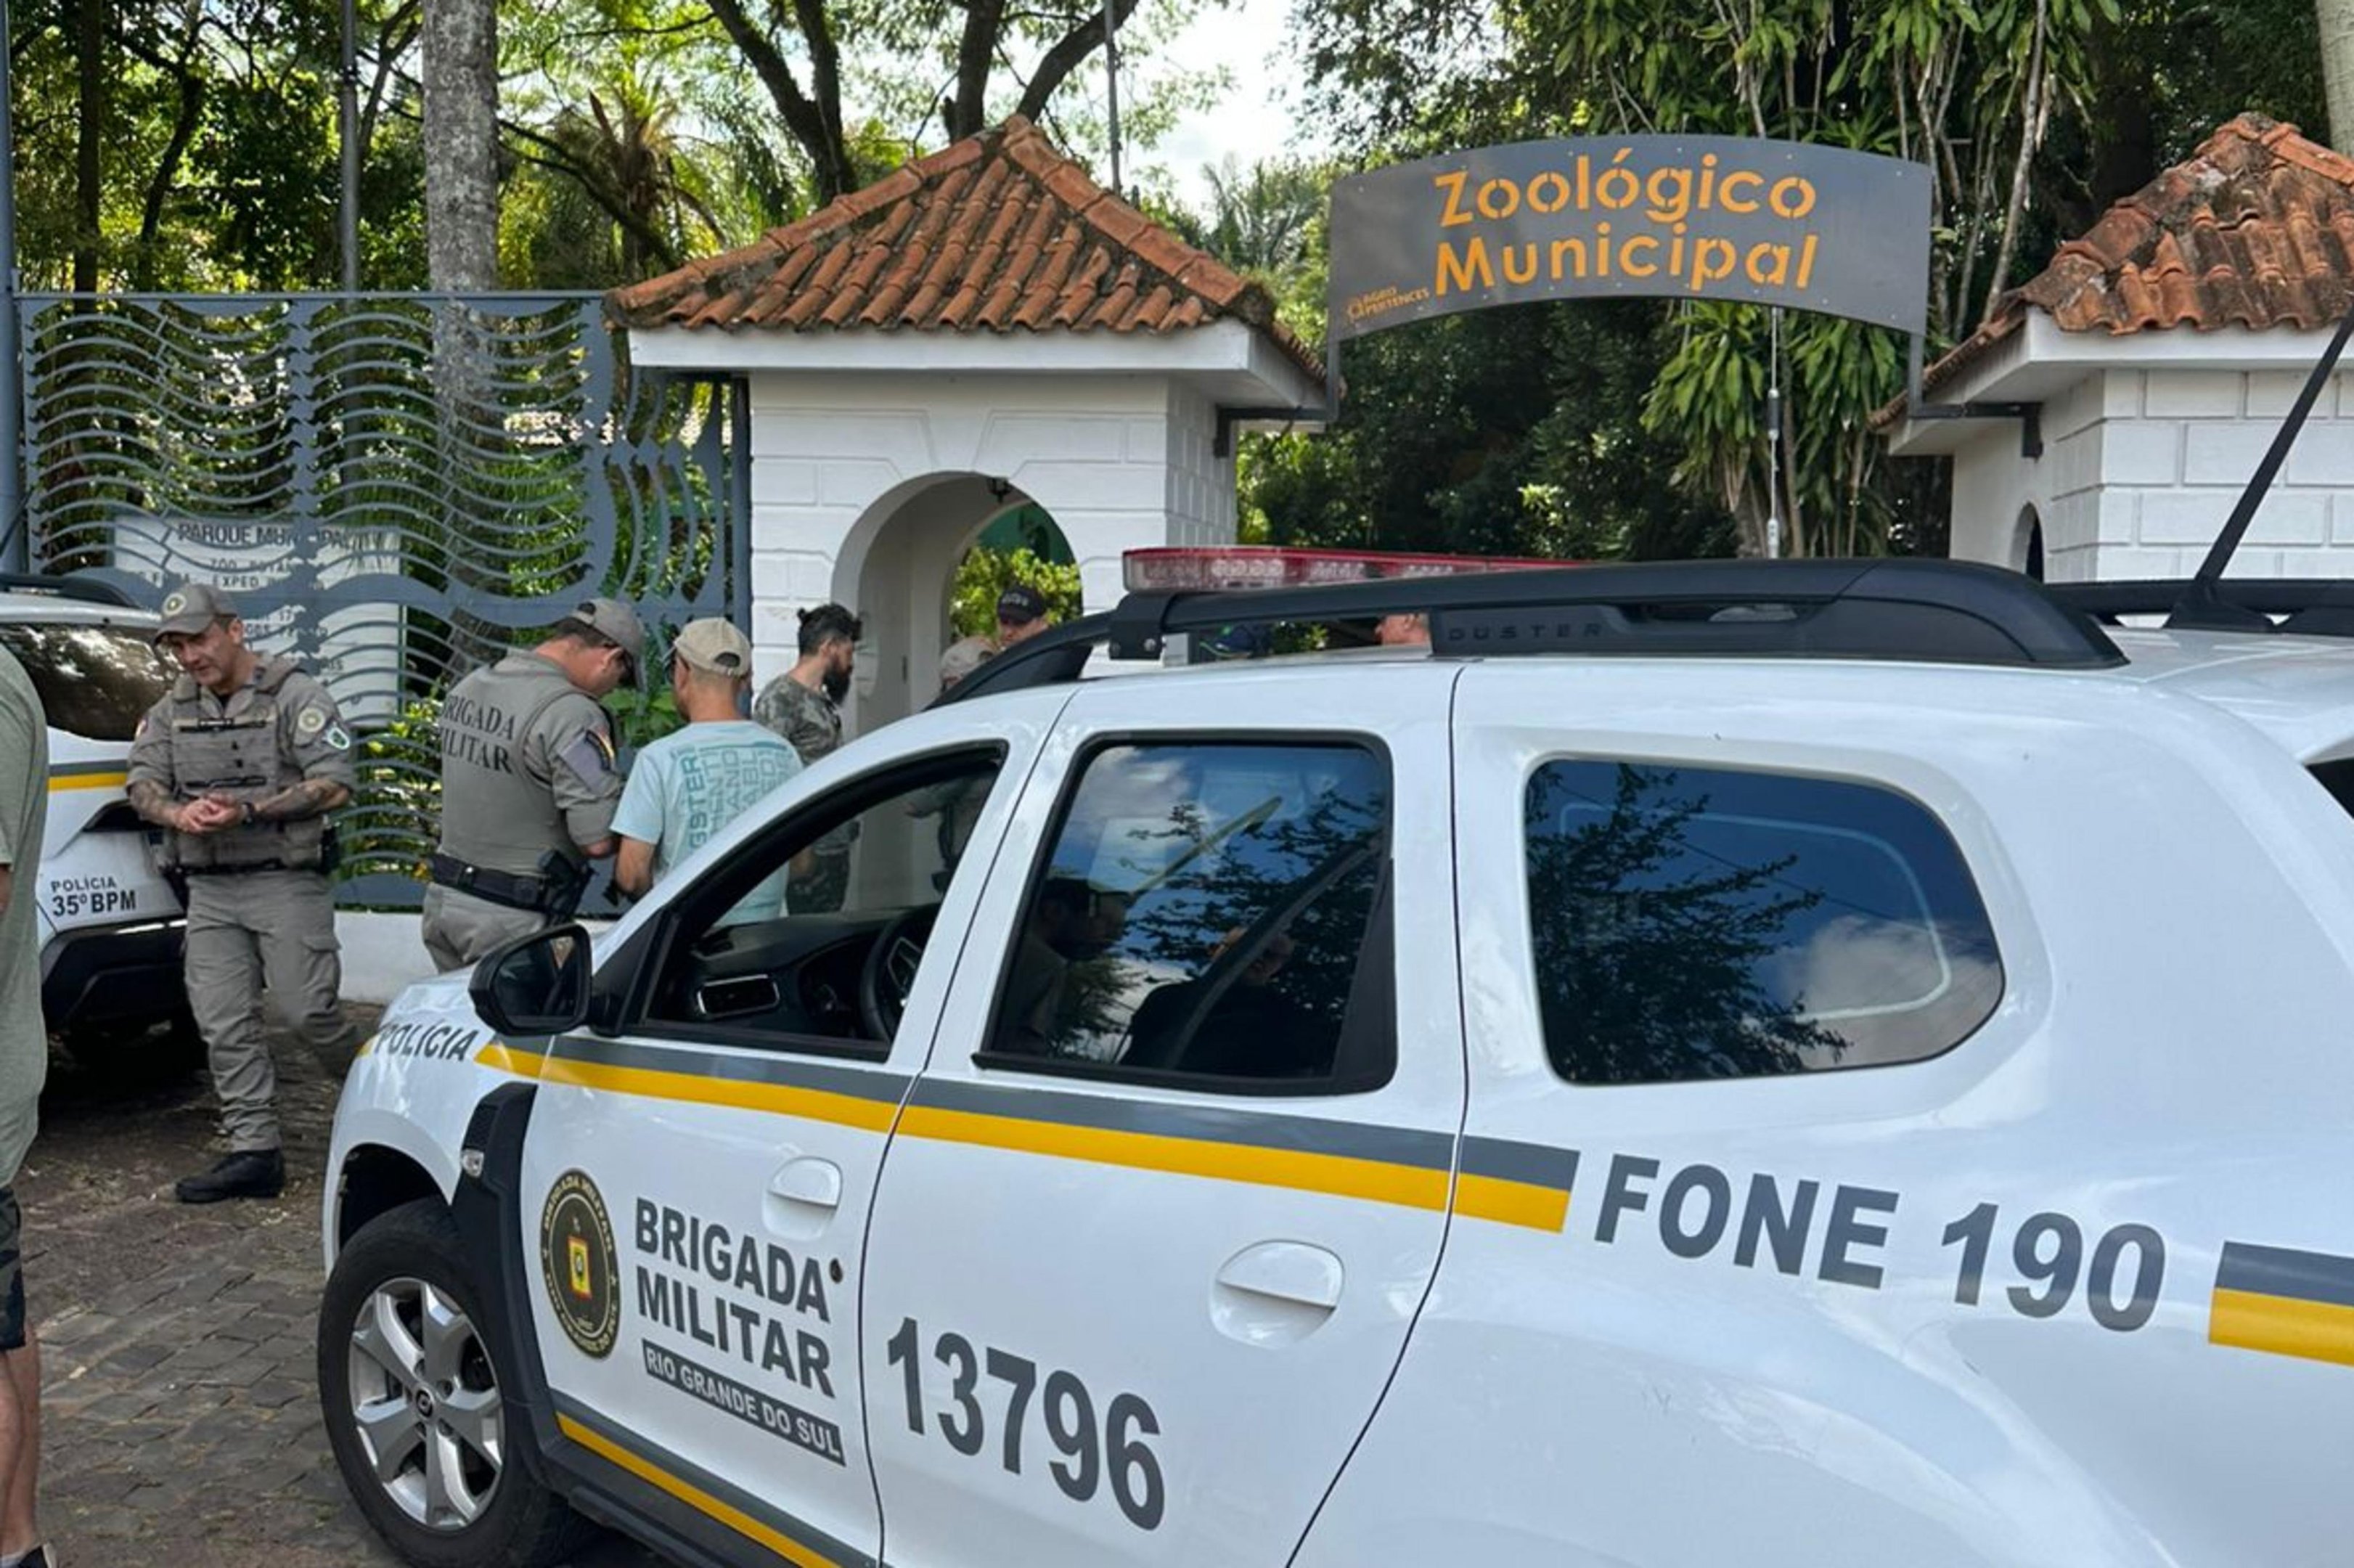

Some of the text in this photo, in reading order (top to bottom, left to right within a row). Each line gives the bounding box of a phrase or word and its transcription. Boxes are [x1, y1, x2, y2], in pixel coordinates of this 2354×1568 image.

[1434, 147, 1816, 227] Zoológico
[1435, 221, 1818, 296] Municipal
[179, 523, 251, 544] PARQUE
[1448, 623, 1602, 641] DUSTER
[444, 695, 514, 740] RIGADA
[375, 1018, 479, 1061] POLÍCIA
[636, 1196, 831, 1323] BRIGADA
[1594, 1153, 2166, 1332] FONE 190
[636, 1265, 835, 1399] MILITAR
[645, 1345, 841, 1457] RIO GRANDE DO SUL
[887, 1316, 1166, 1531] 13796
